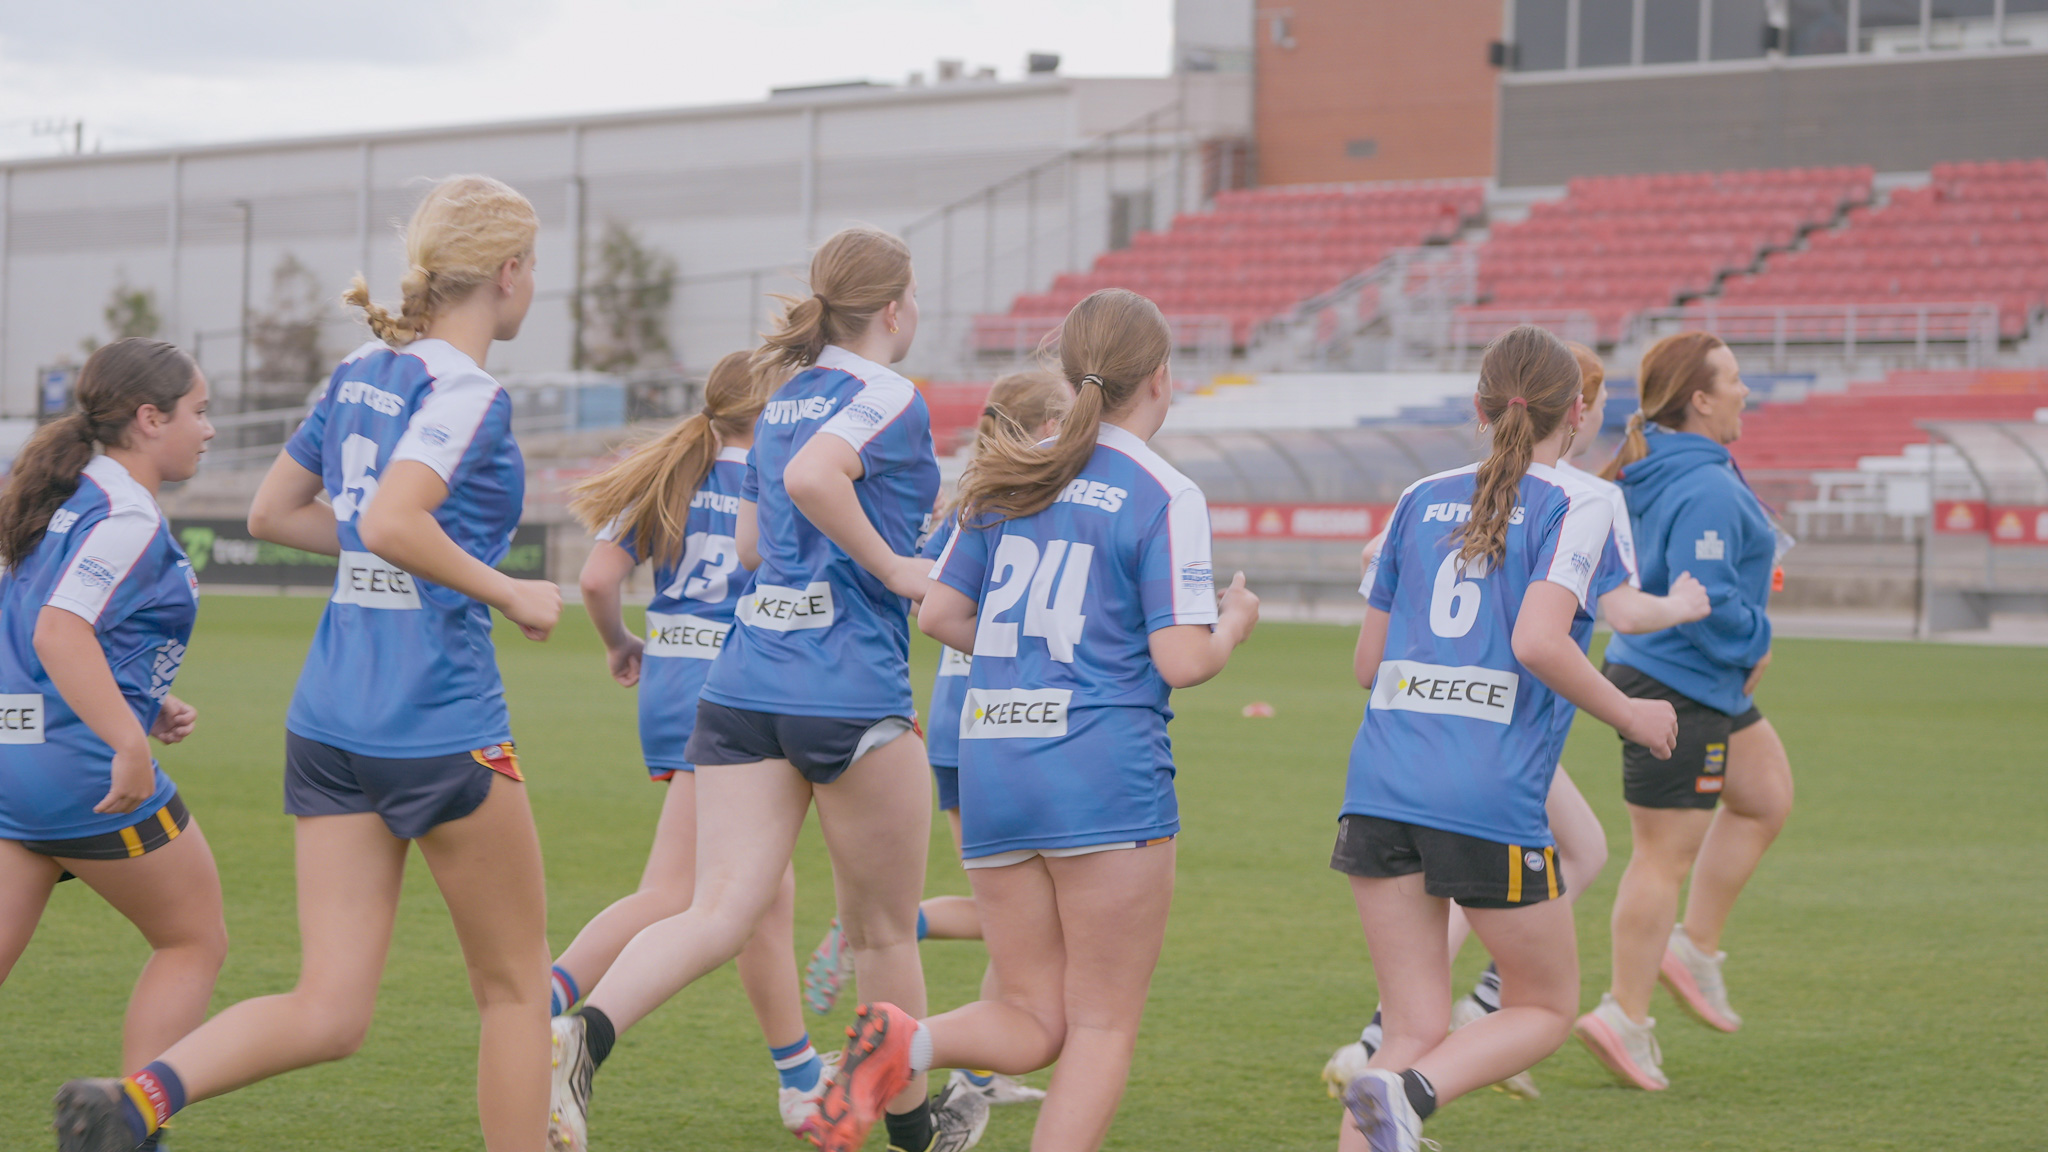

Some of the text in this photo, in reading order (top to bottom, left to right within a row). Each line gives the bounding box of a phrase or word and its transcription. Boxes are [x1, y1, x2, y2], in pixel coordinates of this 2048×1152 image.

[690, 490, 739, 515] UTUR
[1422, 502, 1526, 526] FUTS
[351, 567, 411, 594] EECE
[662, 531, 739, 605] 13
[972, 533, 1096, 664] 24
[1429, 548, 1489, 639] 6
[658, 626, 727, 649] KEECE
[1406, 675, 1509, 709] KEECE
[982, 701, 1061, 726] KEECE
